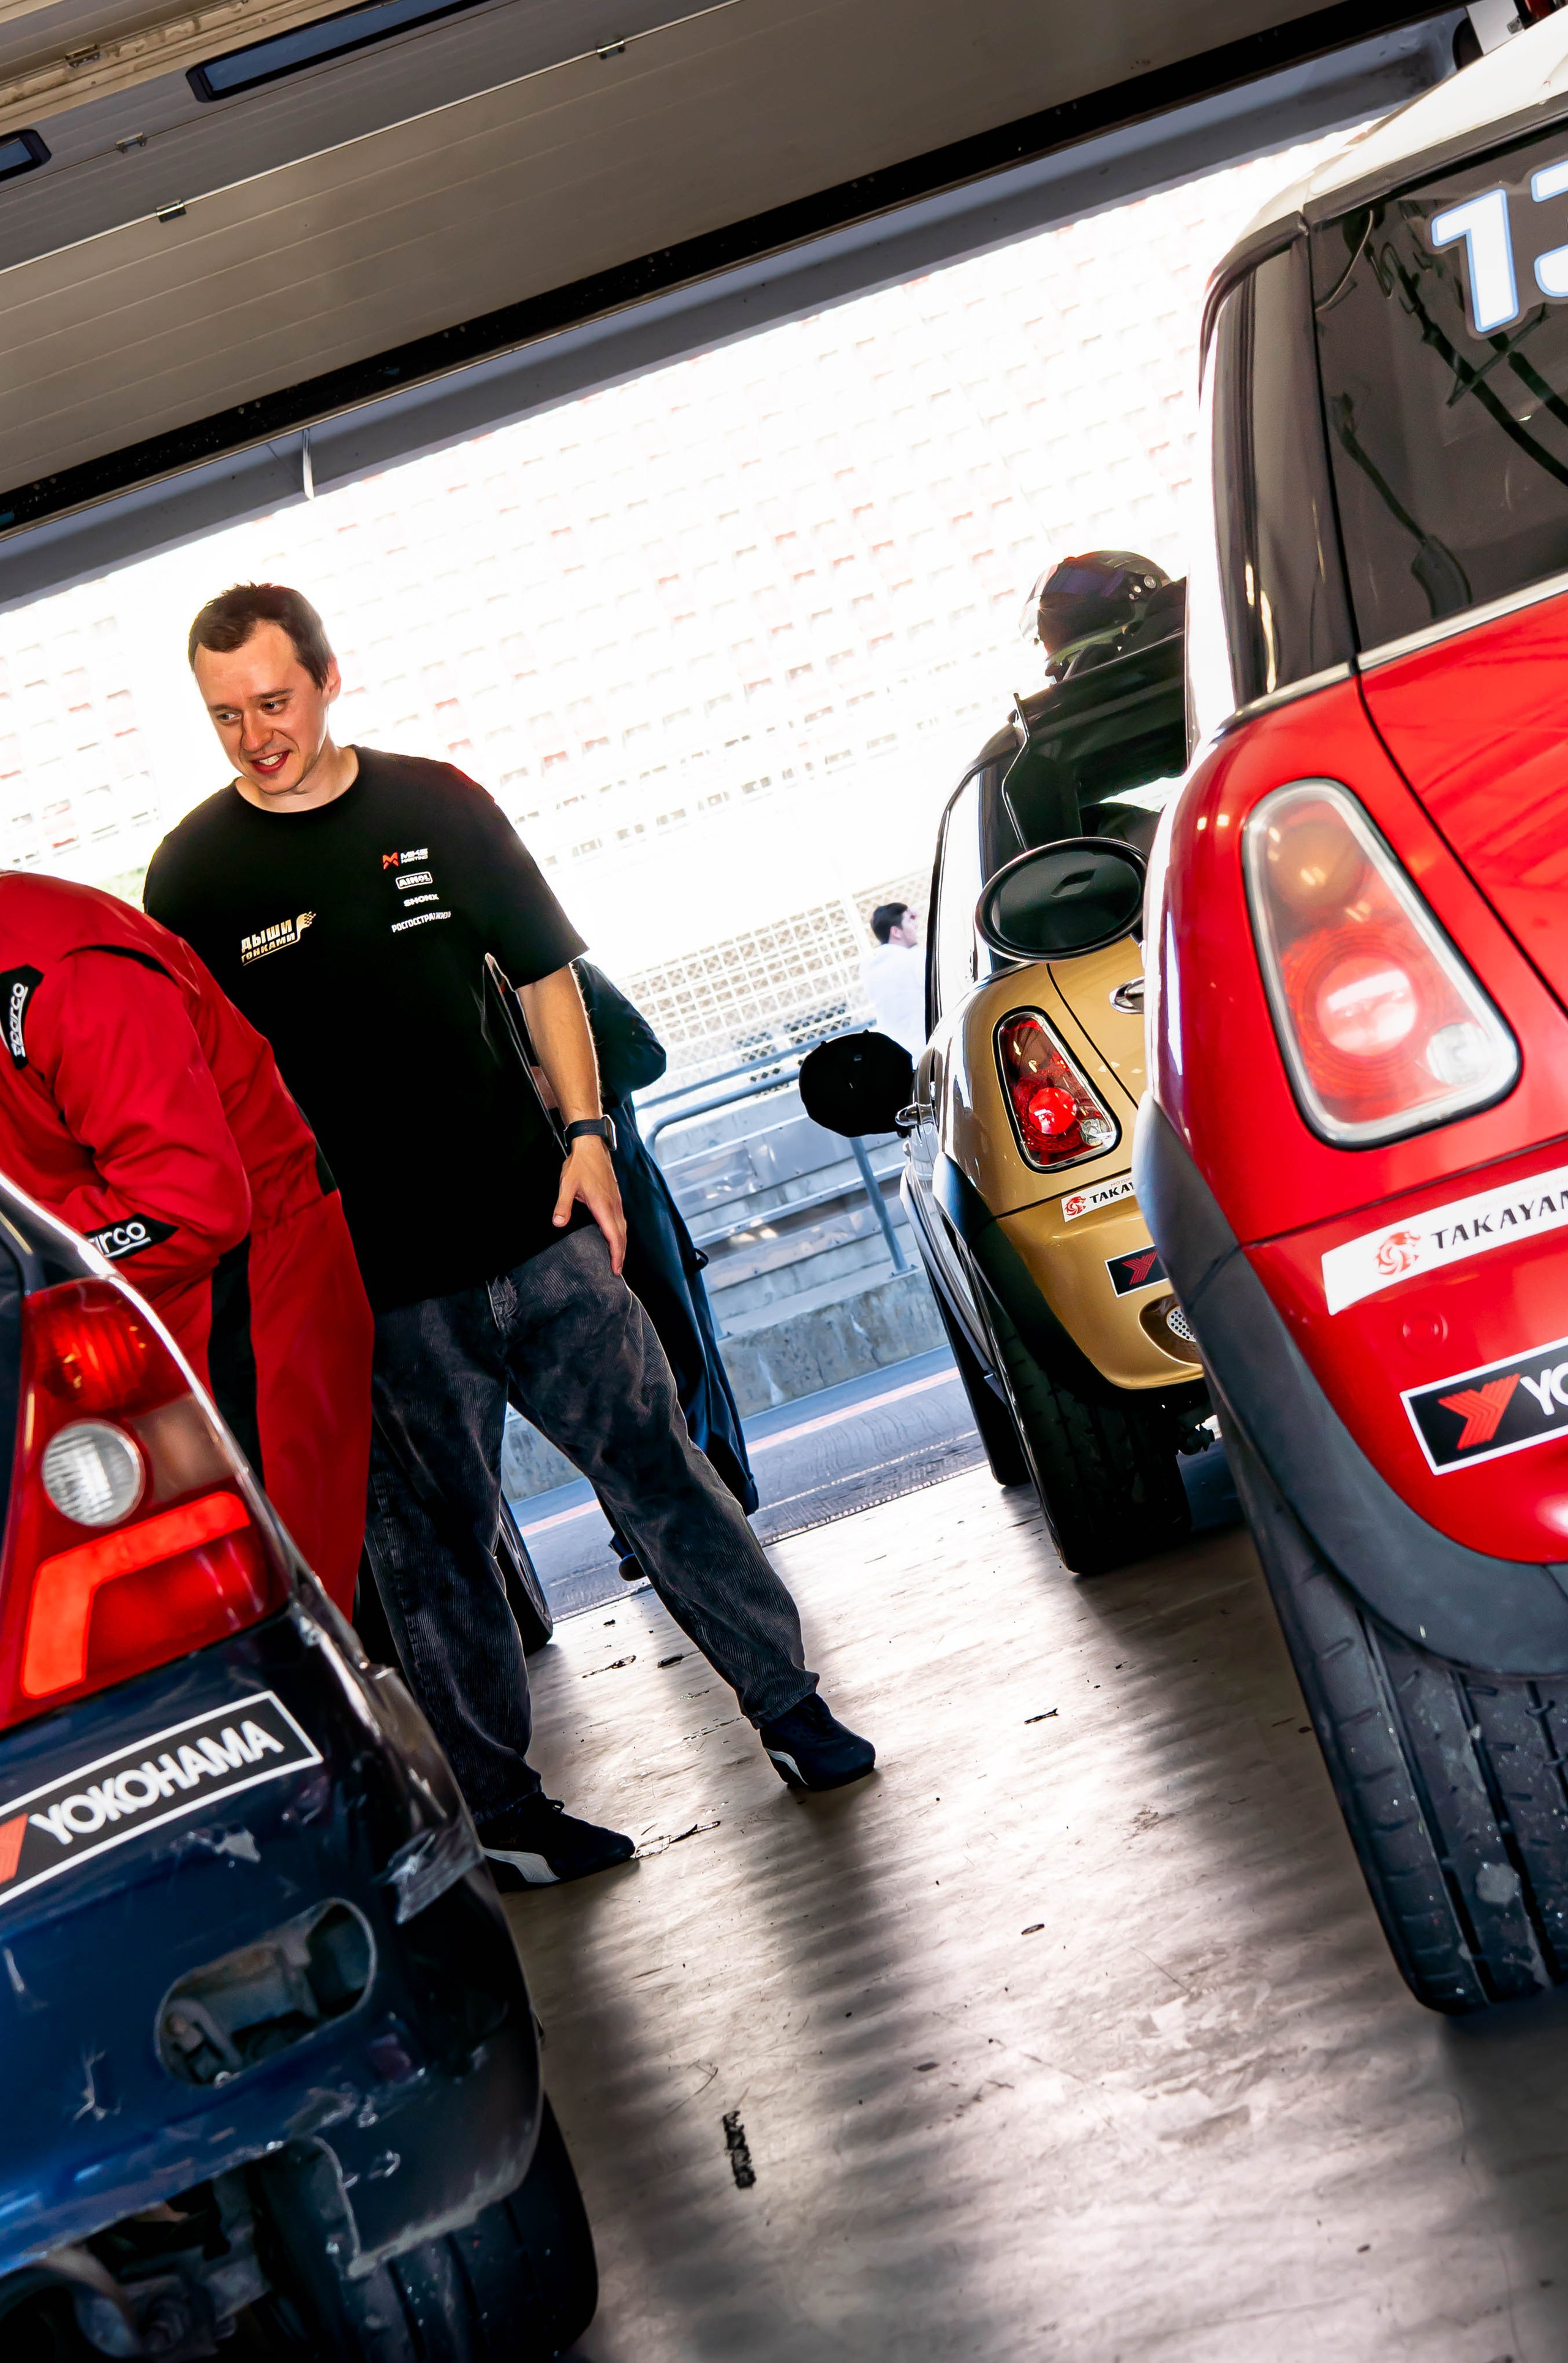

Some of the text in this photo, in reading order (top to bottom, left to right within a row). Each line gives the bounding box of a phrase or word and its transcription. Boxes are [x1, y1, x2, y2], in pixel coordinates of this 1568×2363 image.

[241, 919, 293, 953] ДЫШИ
[241, 932, 295, 964] ГОНКАМИ
[10, 983, 26, 1057] sparco
[29, 1720, 285, 1845] YOKOHAMA
